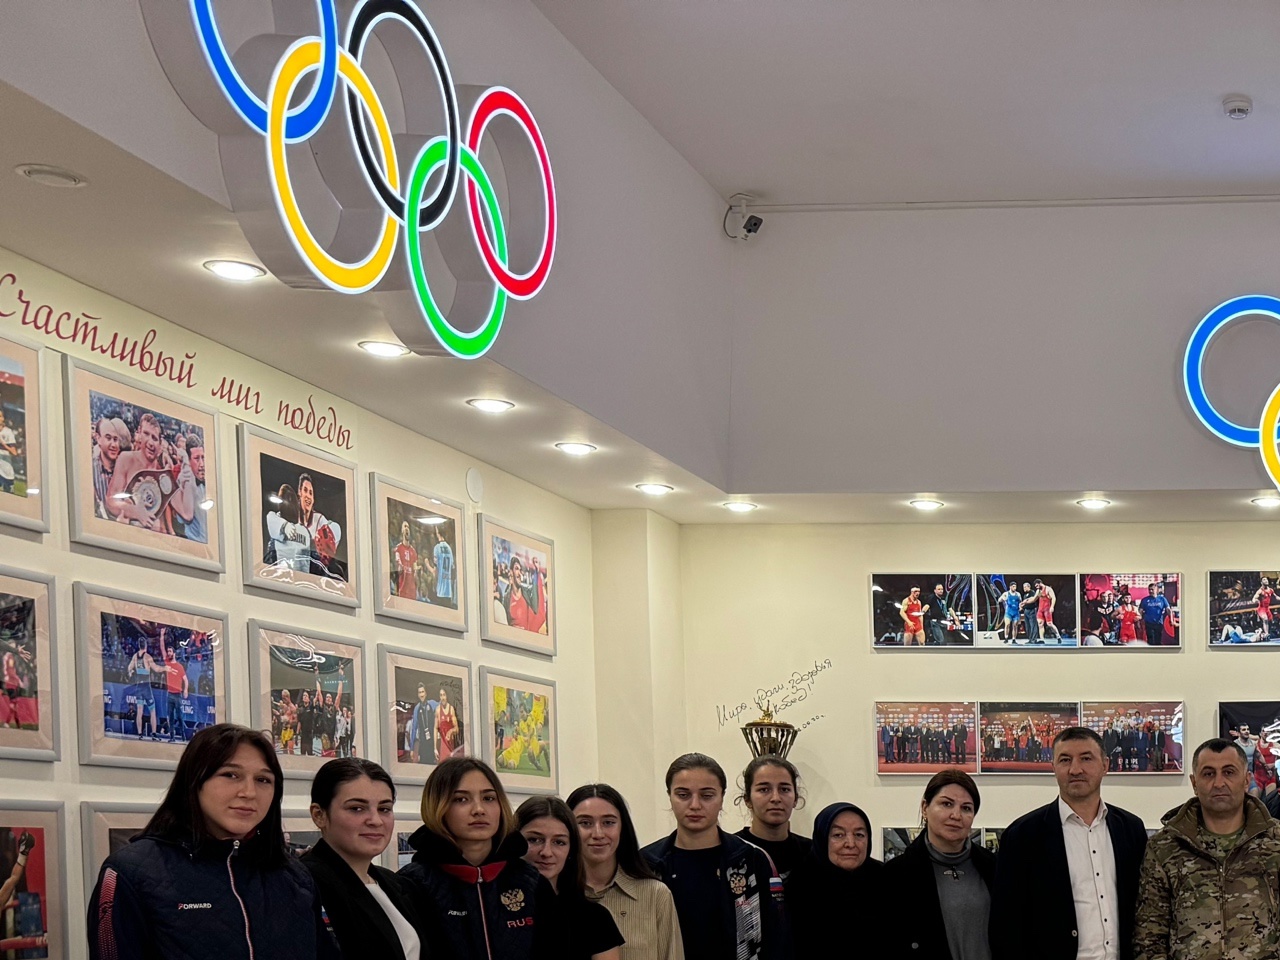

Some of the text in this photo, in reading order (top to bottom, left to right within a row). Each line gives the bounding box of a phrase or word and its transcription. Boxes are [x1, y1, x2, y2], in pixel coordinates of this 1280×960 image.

[0, 273, 354, 450] Счастливый миг победы
[178, 902, 212, 910] FORWARD
[506, 916, 534, 928] RUS
